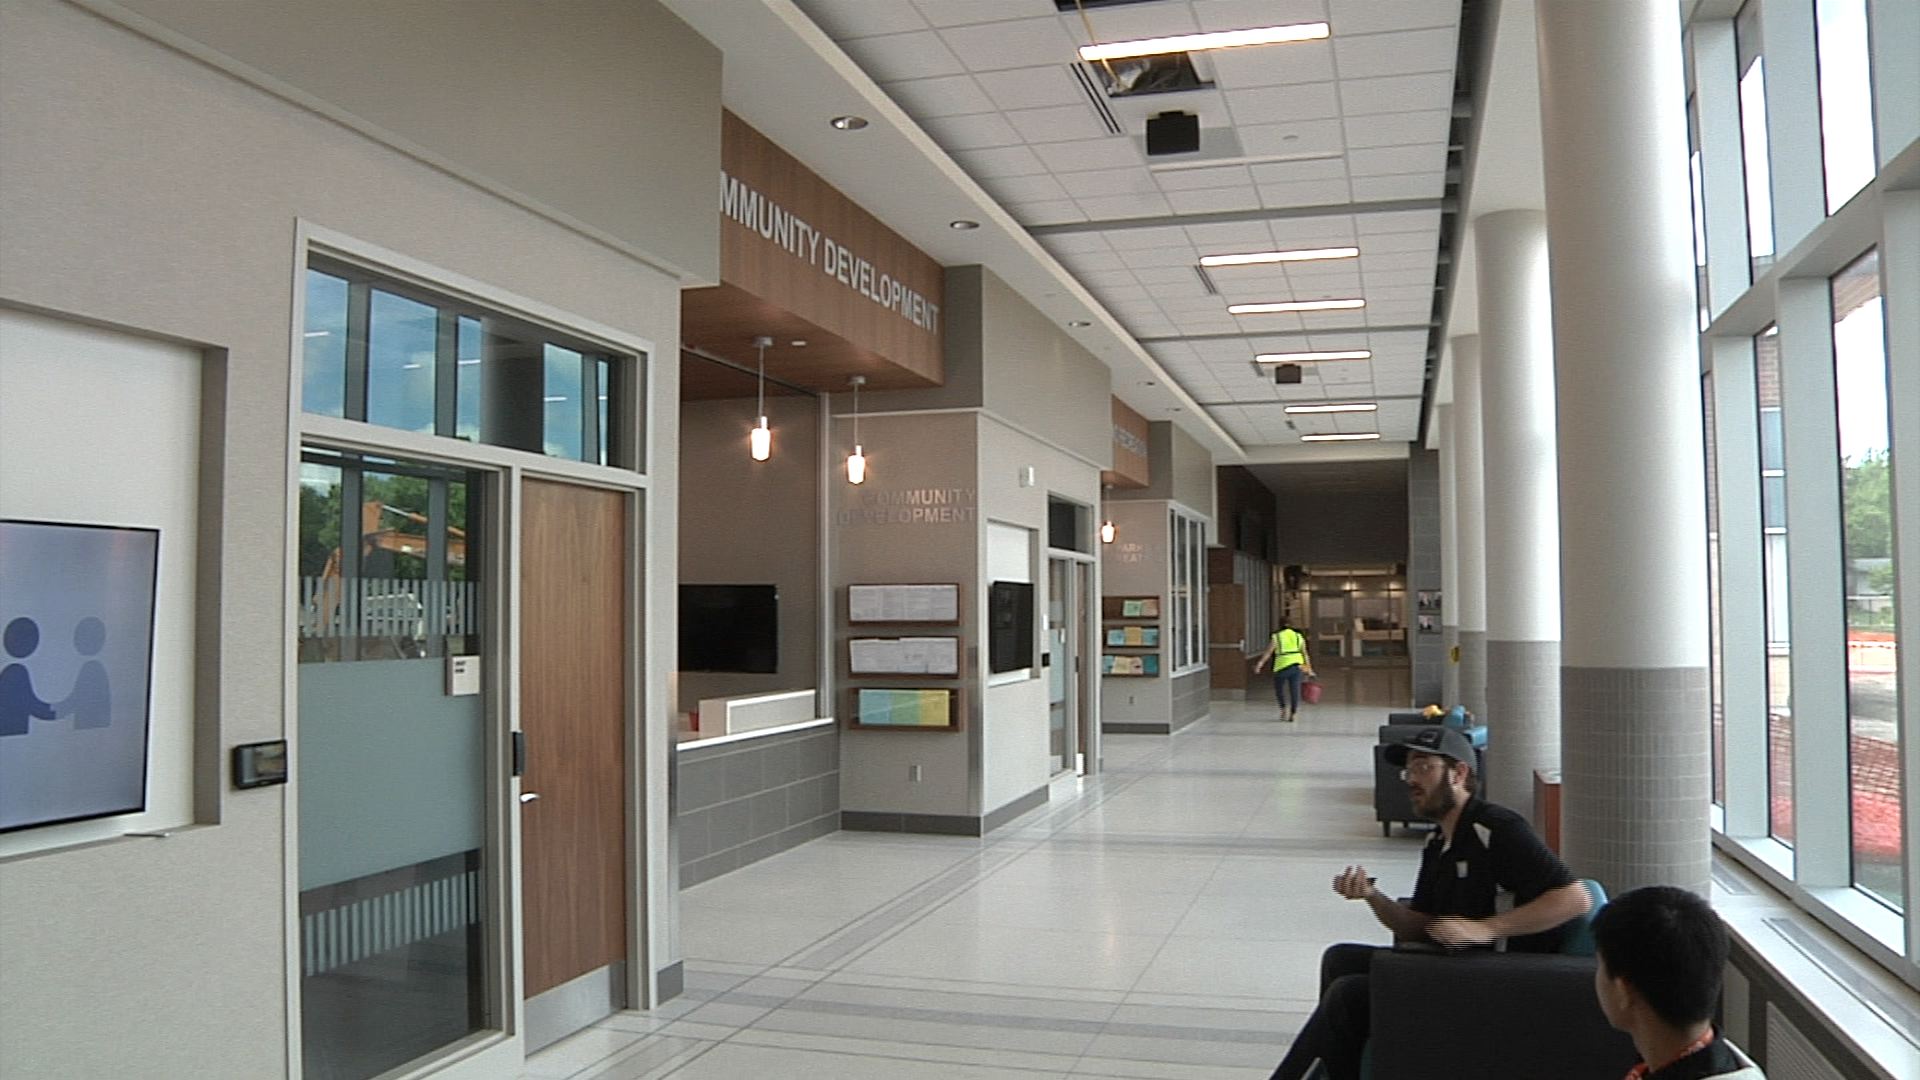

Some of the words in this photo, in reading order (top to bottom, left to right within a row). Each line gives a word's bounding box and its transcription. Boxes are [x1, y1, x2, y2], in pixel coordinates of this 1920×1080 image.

[720, 171, 821, 265] MMUNITY
[824, 237, 940, 335] DEVELOPMENT
[863, 488, 976, 505] COMMUNITY
